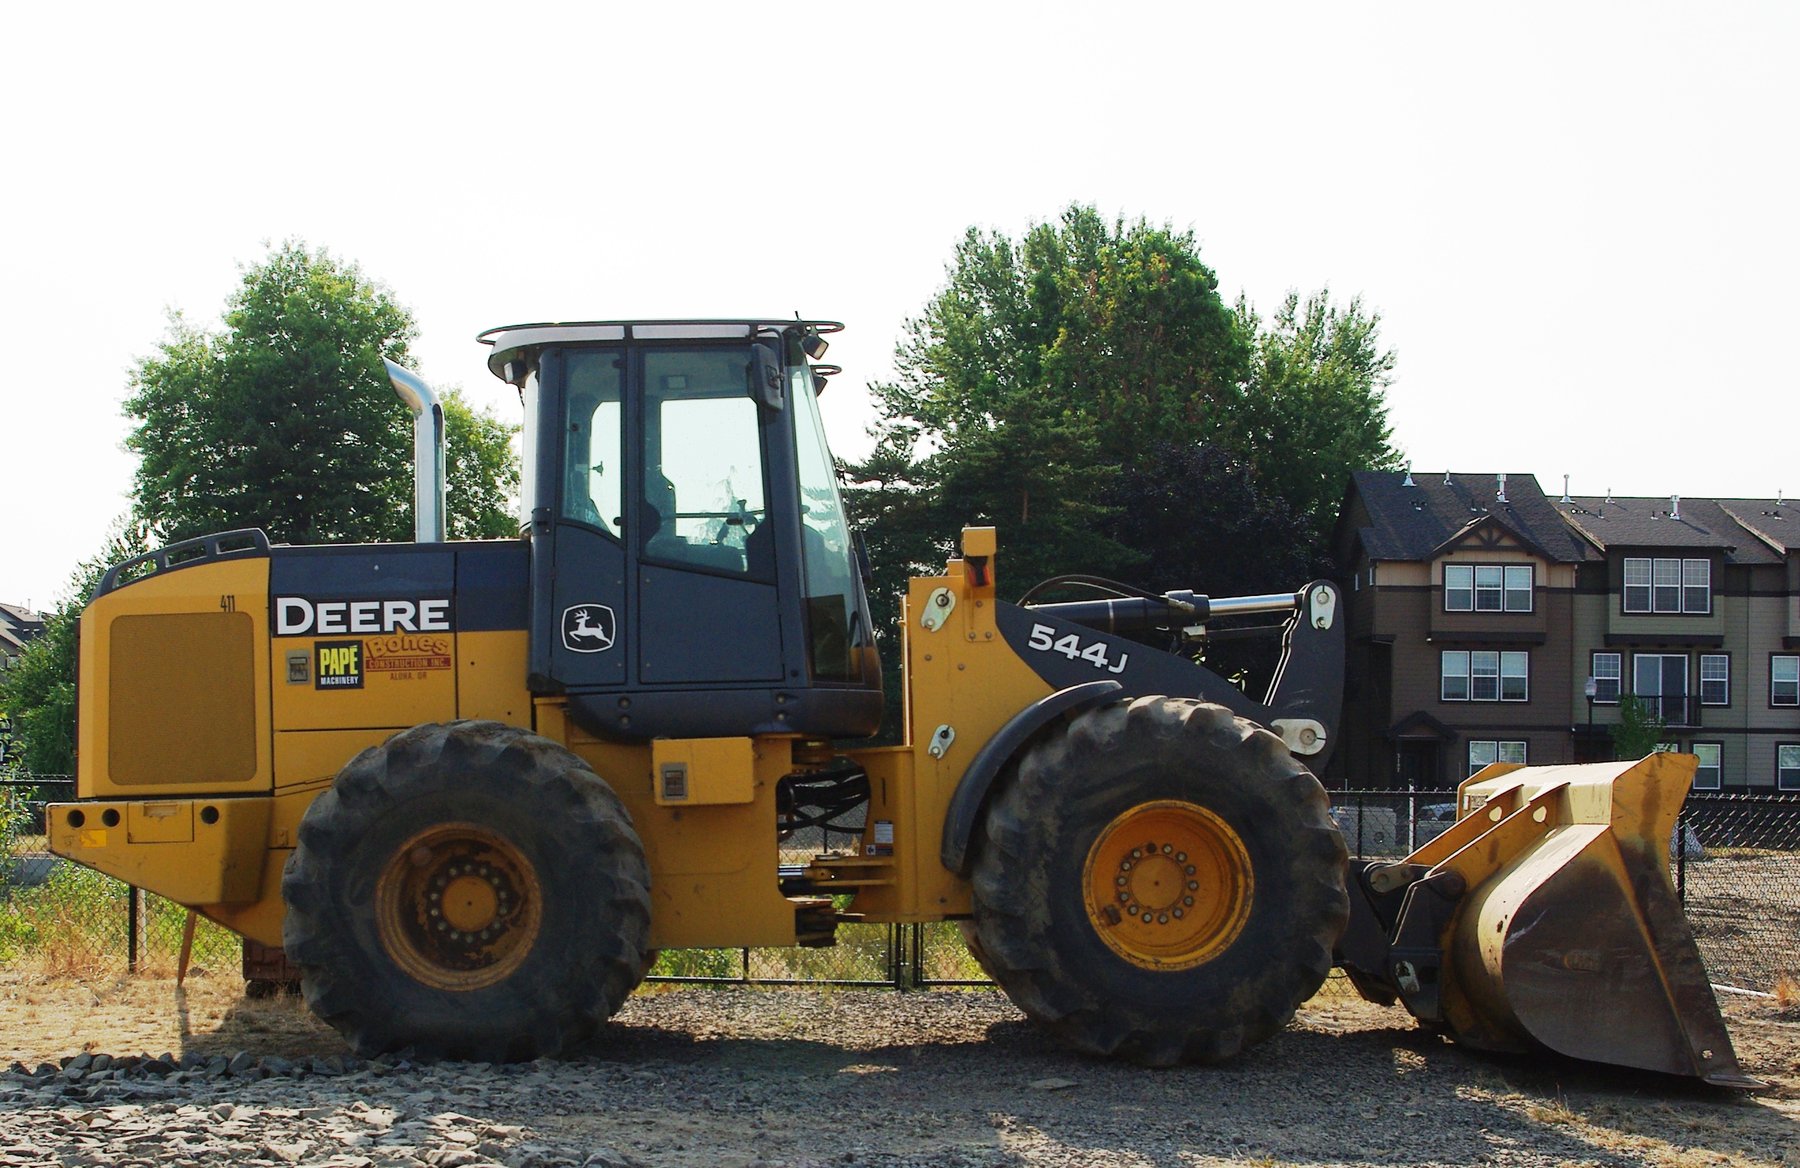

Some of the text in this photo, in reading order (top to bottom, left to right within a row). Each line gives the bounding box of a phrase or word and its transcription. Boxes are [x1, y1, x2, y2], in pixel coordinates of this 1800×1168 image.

[220, 594, 236, 613] 411
[276, 597, 450, 635] DEERE
[365, 635, 449, 659] Bones
[1028, 623, 1128, 674] 544J
[319, 645, 359, 676] PAPÉ
[369, 659, 429, 669] CONSTRUCTION
[320, 676, 359, 685] MACHINERY
